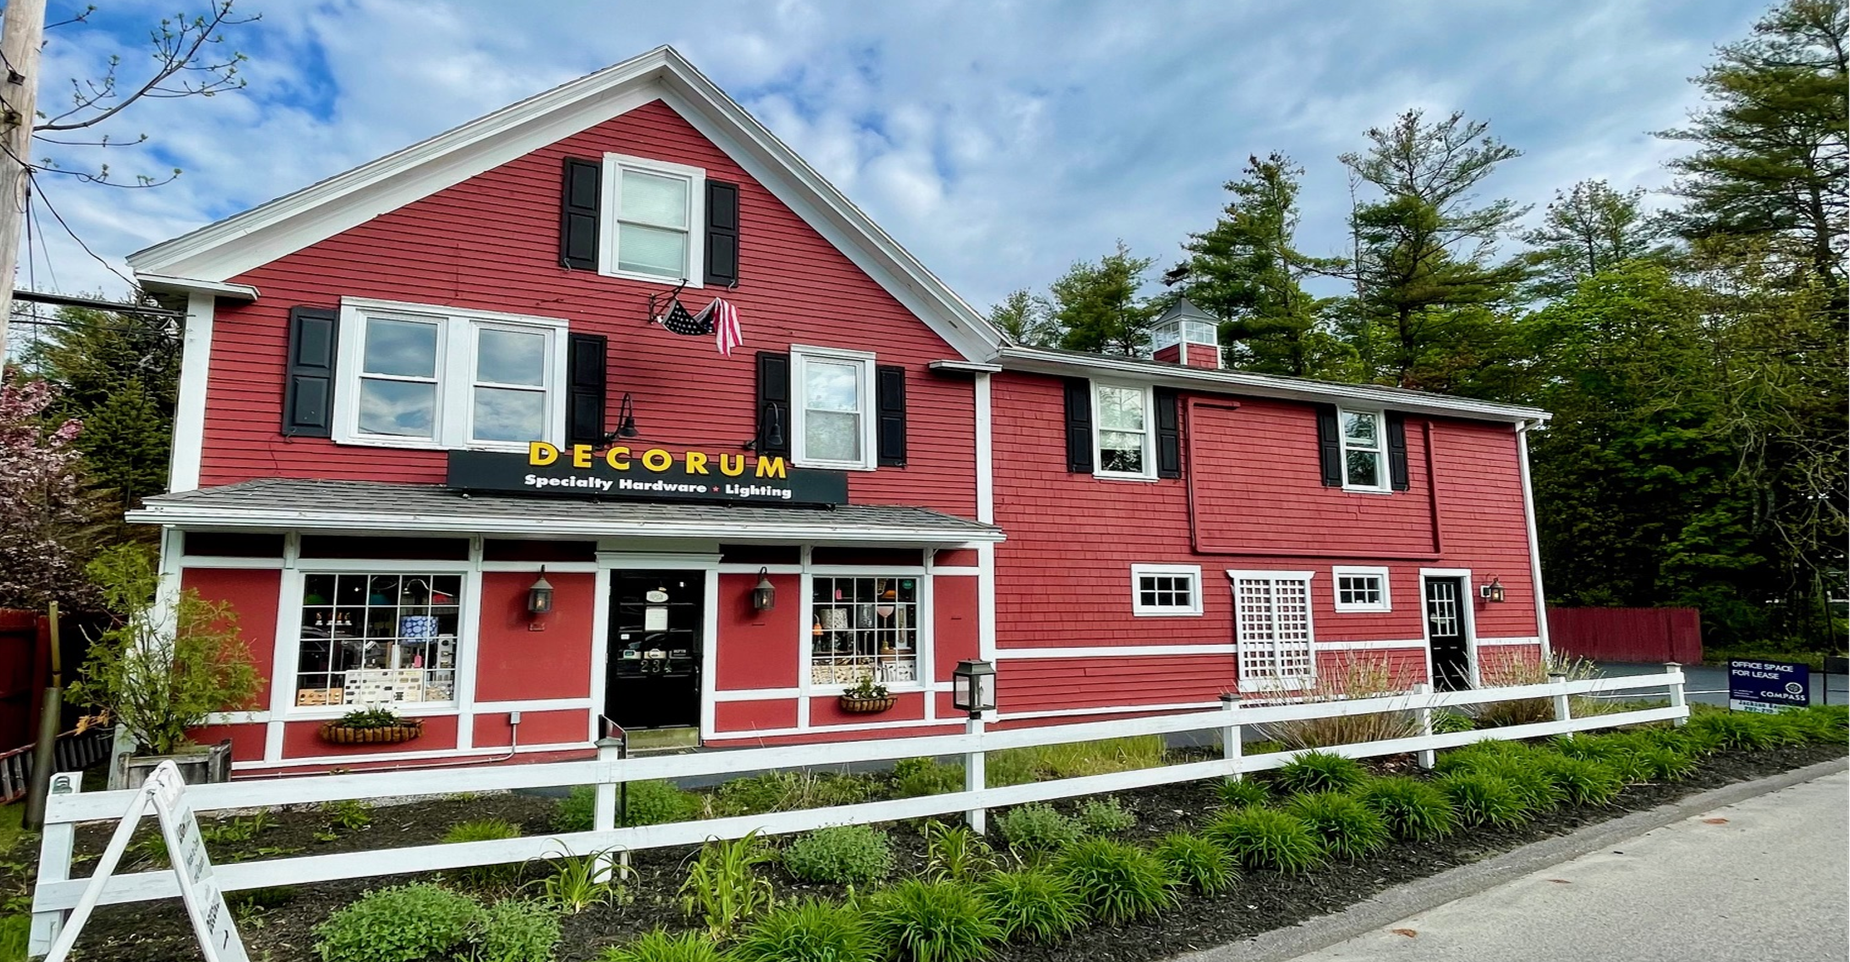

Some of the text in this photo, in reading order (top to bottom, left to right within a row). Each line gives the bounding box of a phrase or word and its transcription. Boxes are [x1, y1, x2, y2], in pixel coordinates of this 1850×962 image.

[529, 441, 787, 479] DECORUM
[524, 474, 792, 499] Specialty Hardware Lighting
[640, 660, 672, 673] 234
[1732, 661, 1794, 673] OFFICE SPACE
[1732, 669, 1779, 679] FOR LEASE
[1760, 691, 1805, 701] COMPASS
